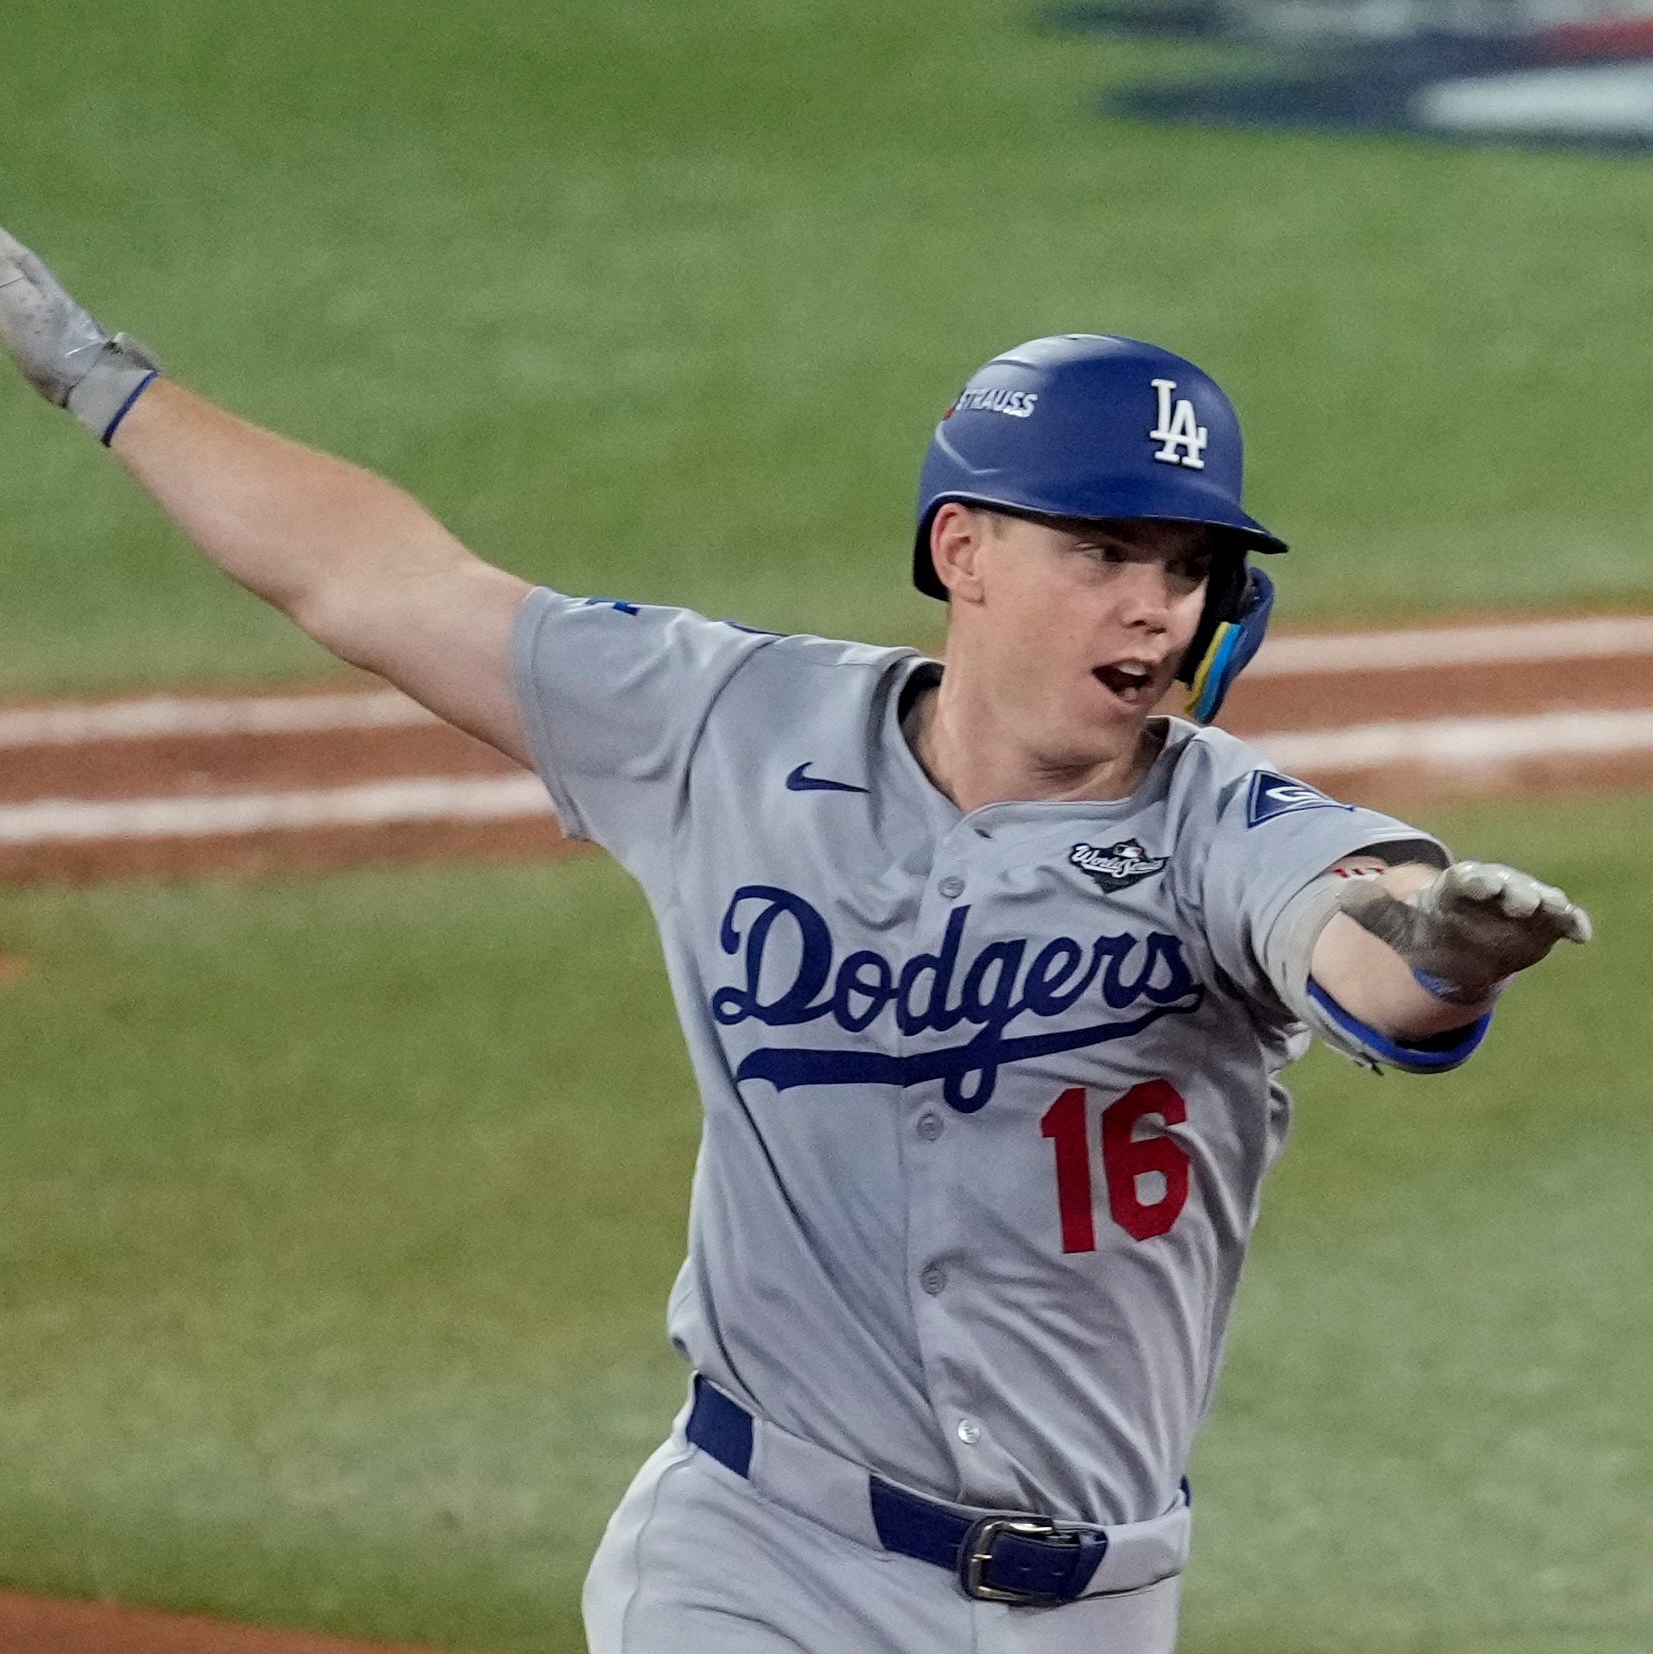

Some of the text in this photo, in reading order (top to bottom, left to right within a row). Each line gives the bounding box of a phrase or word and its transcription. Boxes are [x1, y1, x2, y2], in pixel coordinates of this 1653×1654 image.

[1149, 378, 1208, 469] LA
[712, 885, 1206, 1114] Dodgers
[1040, 1079, 1190, 1254] 16
